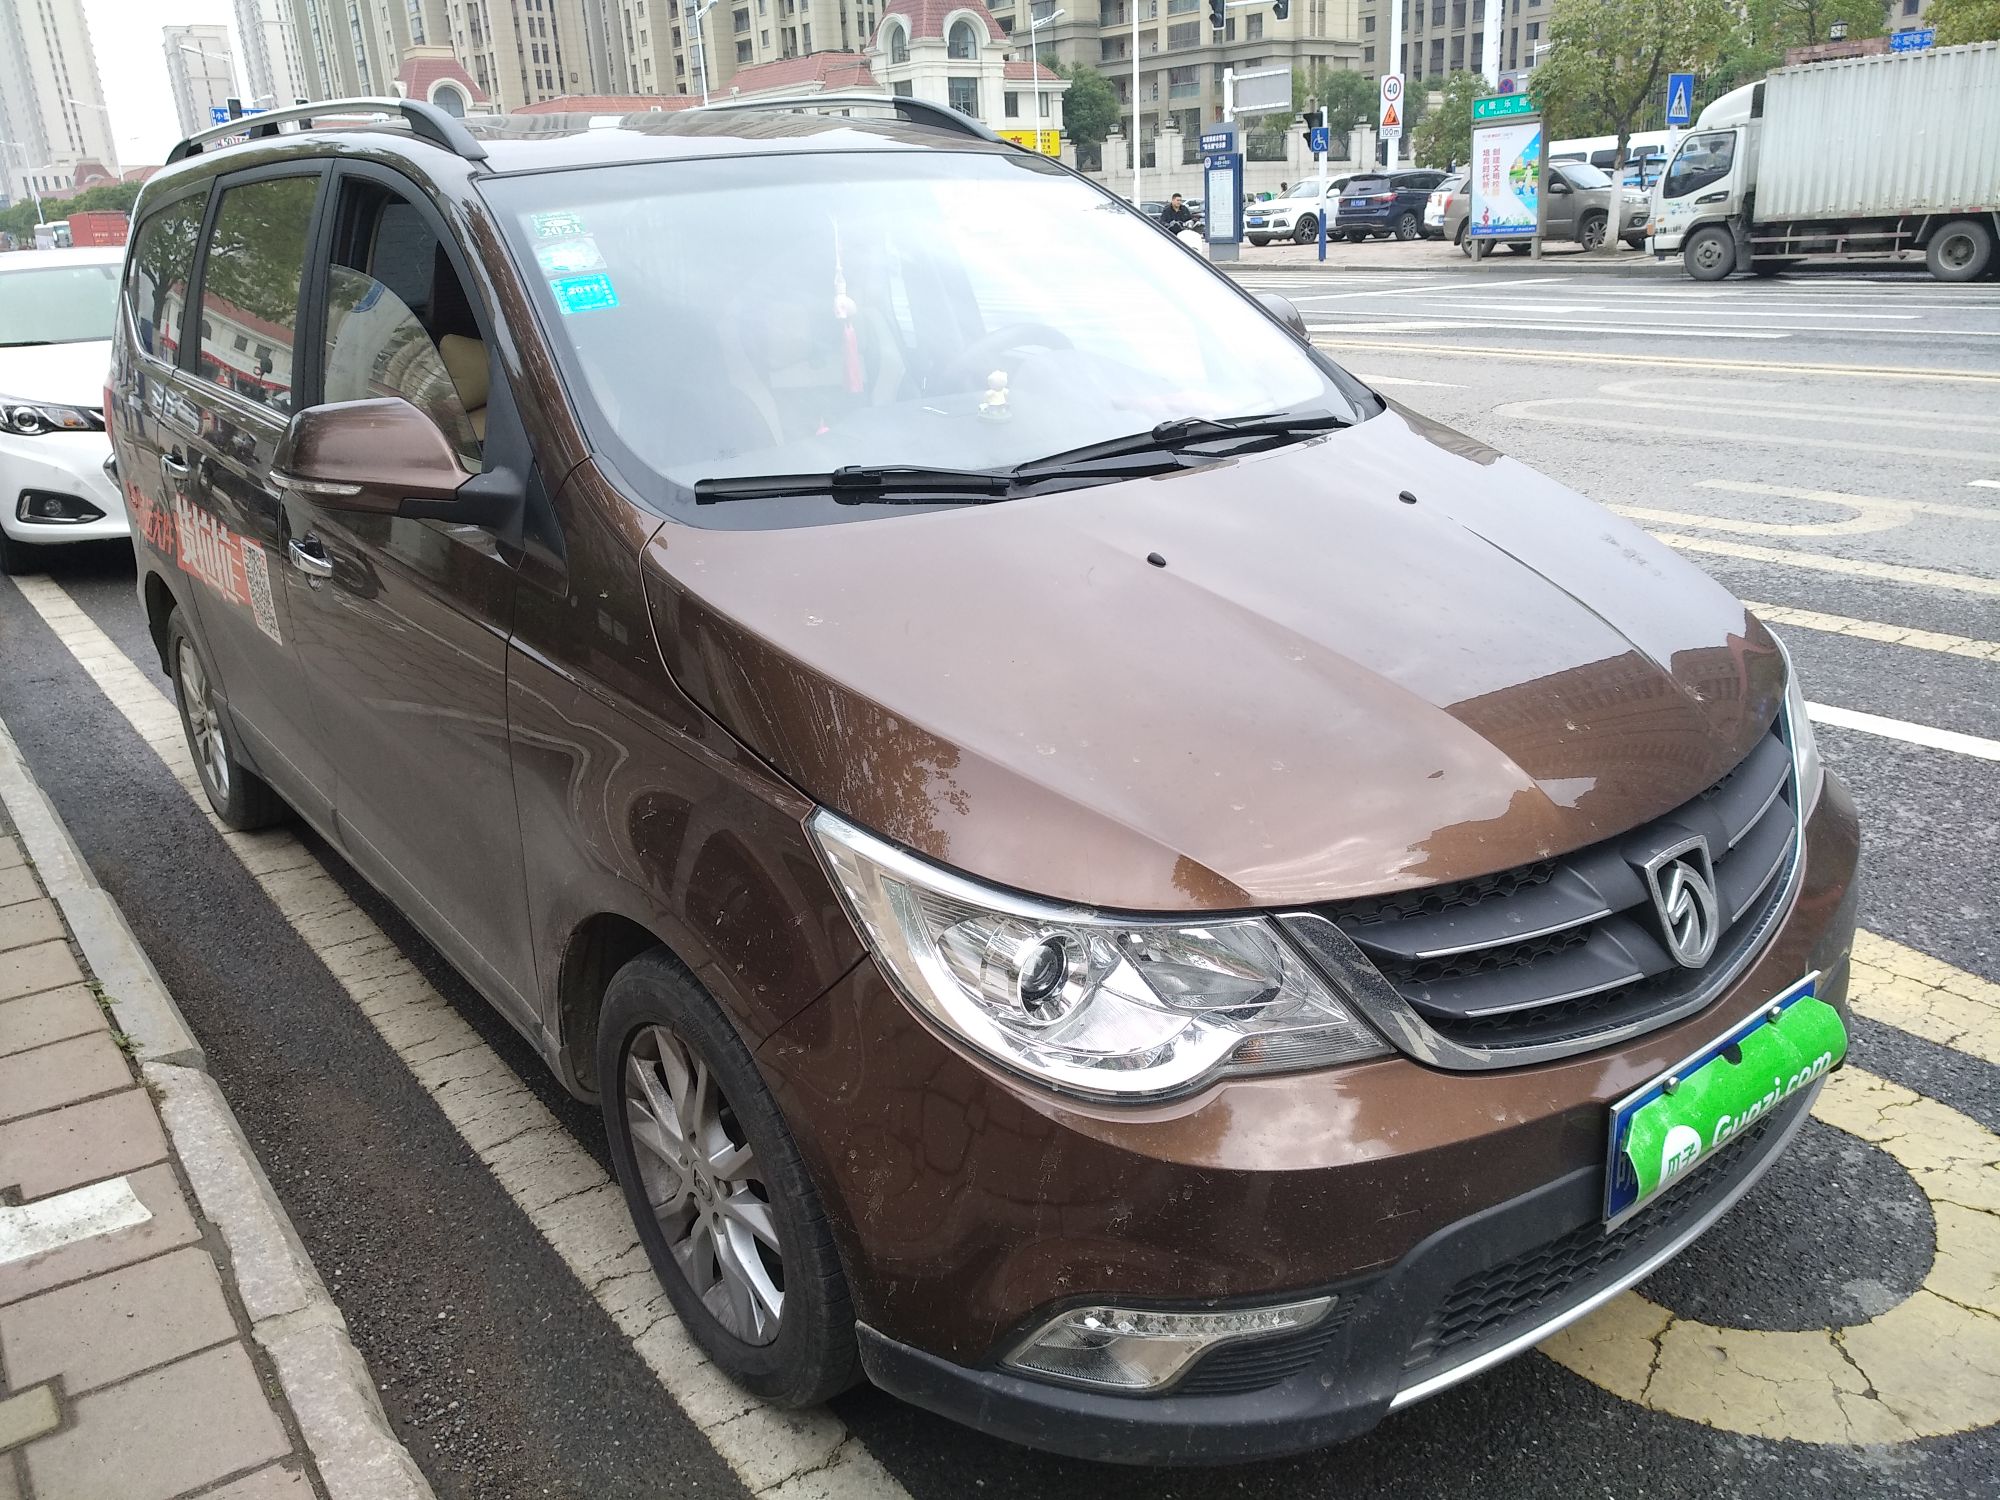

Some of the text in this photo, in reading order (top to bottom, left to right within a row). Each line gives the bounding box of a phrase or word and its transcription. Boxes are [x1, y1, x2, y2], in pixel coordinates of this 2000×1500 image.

[1387, 83, 1398, 94] 40
[542, 224, 581, 237] 2021
[175, 493, 240, 605] 货拉拉
[1712, 1051, 1832, 1148] Guazi.com
